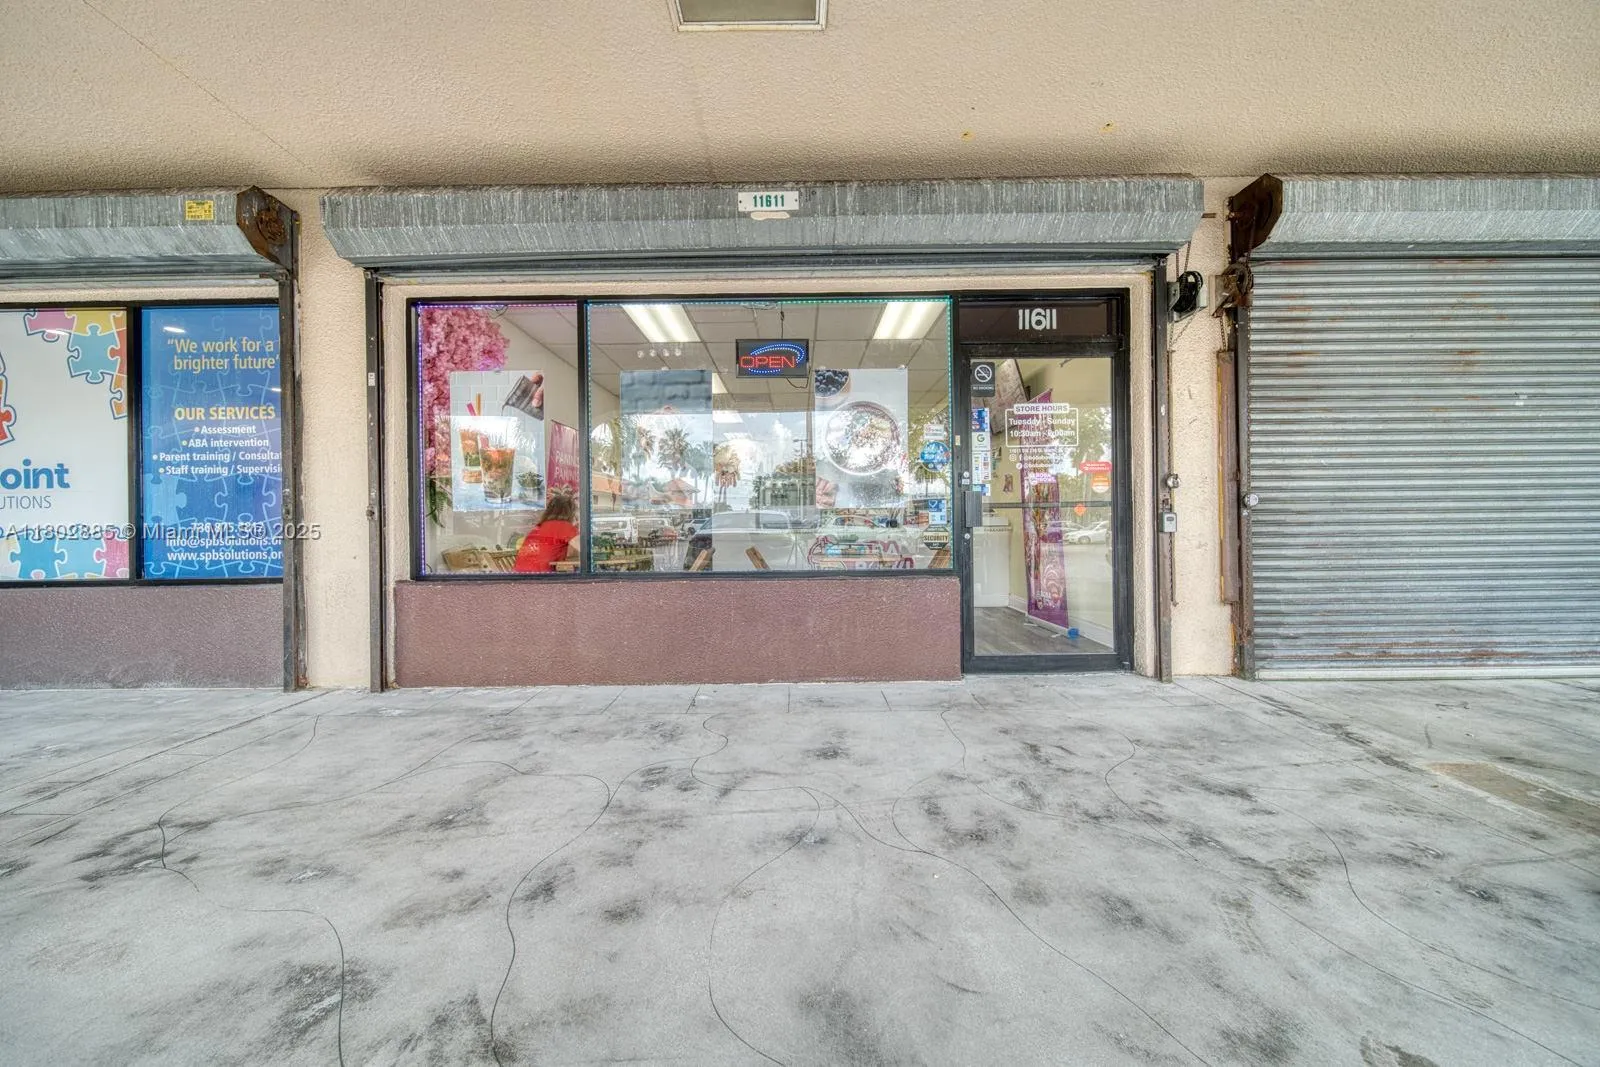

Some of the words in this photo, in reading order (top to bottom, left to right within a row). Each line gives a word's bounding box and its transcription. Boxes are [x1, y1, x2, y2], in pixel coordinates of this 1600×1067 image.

[753, 194, 785, 208] 11611
[1018, 307, 1057, 330] 11611
[202, 337, 238, 352] work
[241, 336, 262, 352] for
[265, 340, 274, 352] a
[174, 355, 230, 374] brighter
[740, 355, 796, 369] OPEN
[174, 407, 206, 420] OUR
[209, 406, 276, 420] SERVICES
[1015, 405, 1040, 413] STORE
[1047, 418, 1076, 427] Sunday
[200, 425, 257, 435] Assessment
[187, 439, 208, 448] ABA
[210, 438, 270, 448] intervention
[159, 452, 190, 461] Parent
[193, 450, 231, 463] training
[0, 458, 71, 490] oint
[165, 465, 189, 475] Staff
[191, 465, 229, 476] training
[923, 534, 949, 542] SECURITY
[167, 549, 283, 562] www.spbsolutions.or
